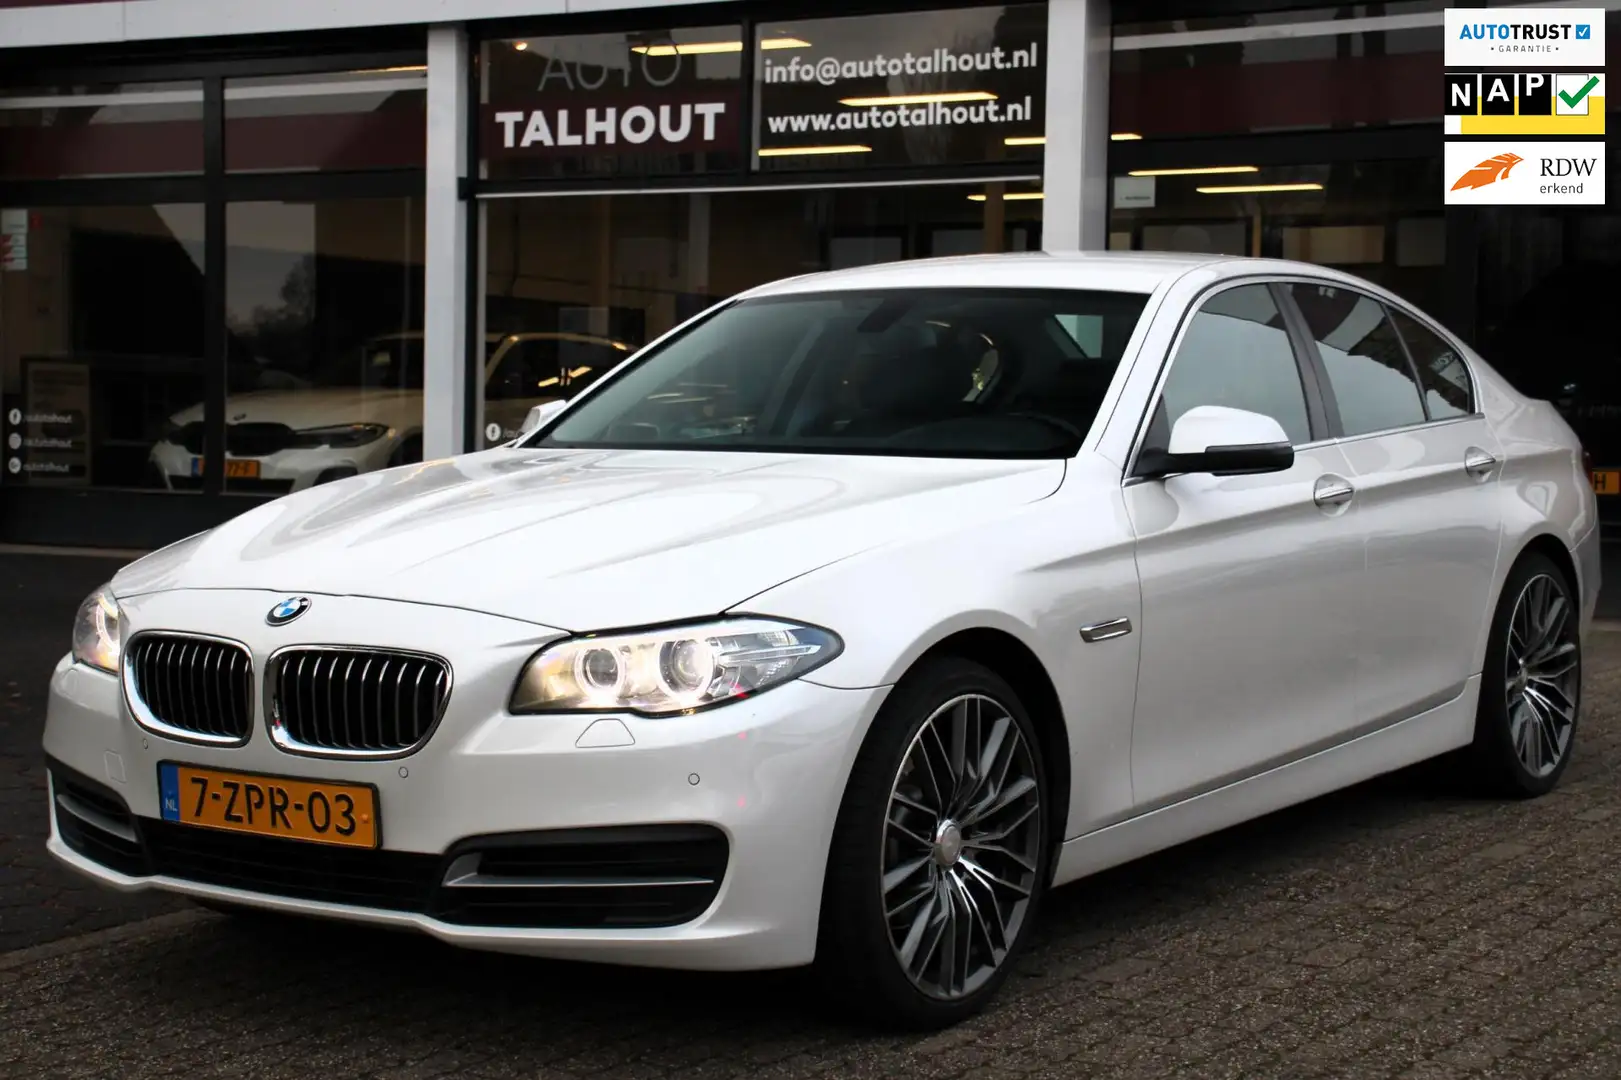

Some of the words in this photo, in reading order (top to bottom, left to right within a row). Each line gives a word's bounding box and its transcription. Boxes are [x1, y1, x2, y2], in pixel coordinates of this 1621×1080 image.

[764, 42, 1038, 85] info@autotalhout.nl
[495, 103, 726, 148] TALHOUT
[768, 96, 1032, 133] www.autotalhout.nl
[164, 797, 178, 812] NL
[190, 776, 358, 837] 7-ZPR-03
